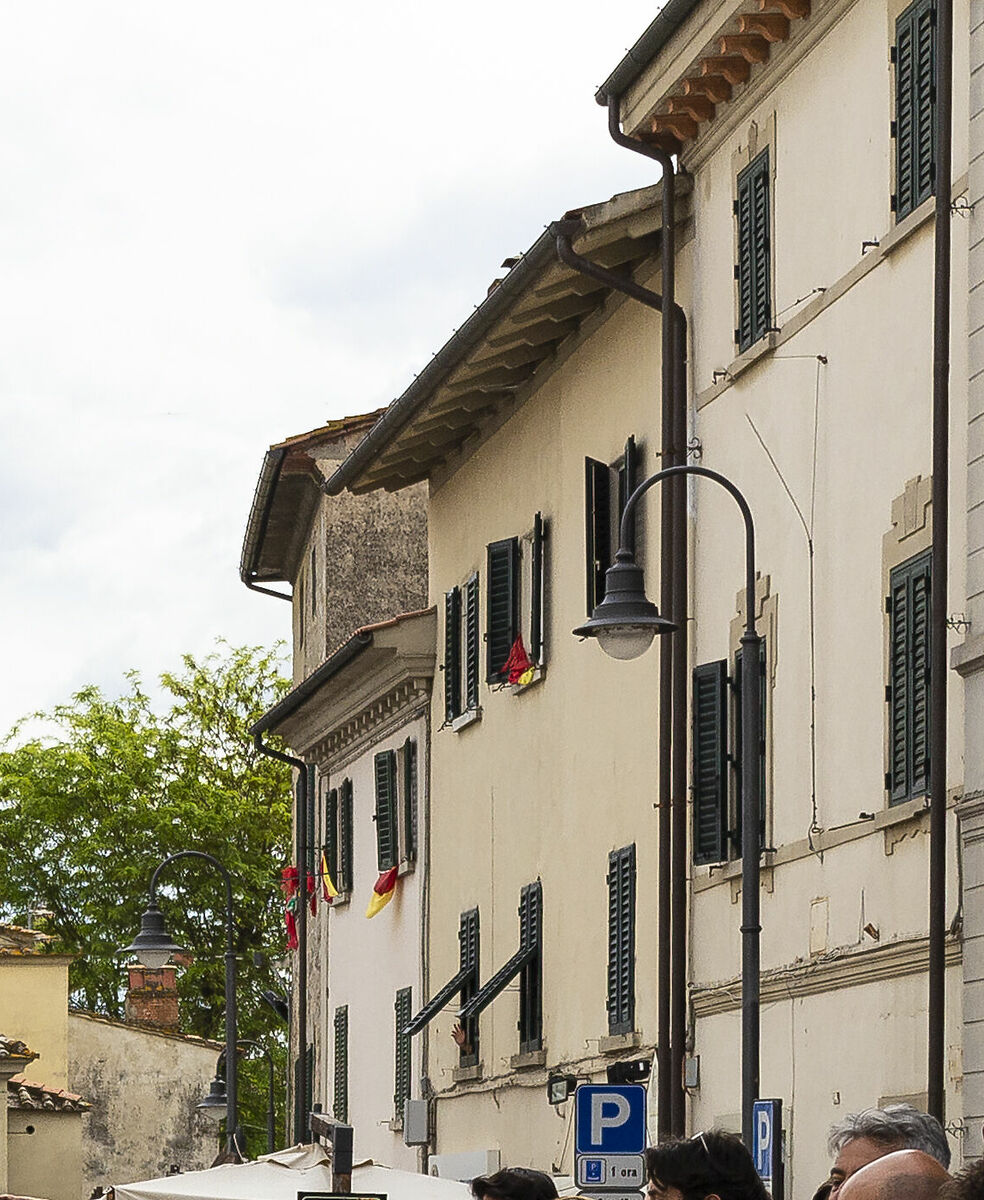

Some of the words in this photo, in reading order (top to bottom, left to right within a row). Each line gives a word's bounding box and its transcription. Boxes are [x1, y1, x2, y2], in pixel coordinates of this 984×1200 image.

[590, 1092, 631, 1146] P
[757, 1110, 770, 1171] P
[611, 1166, 616, 1177] 1
[620, 1168, 638, 1178] ora
